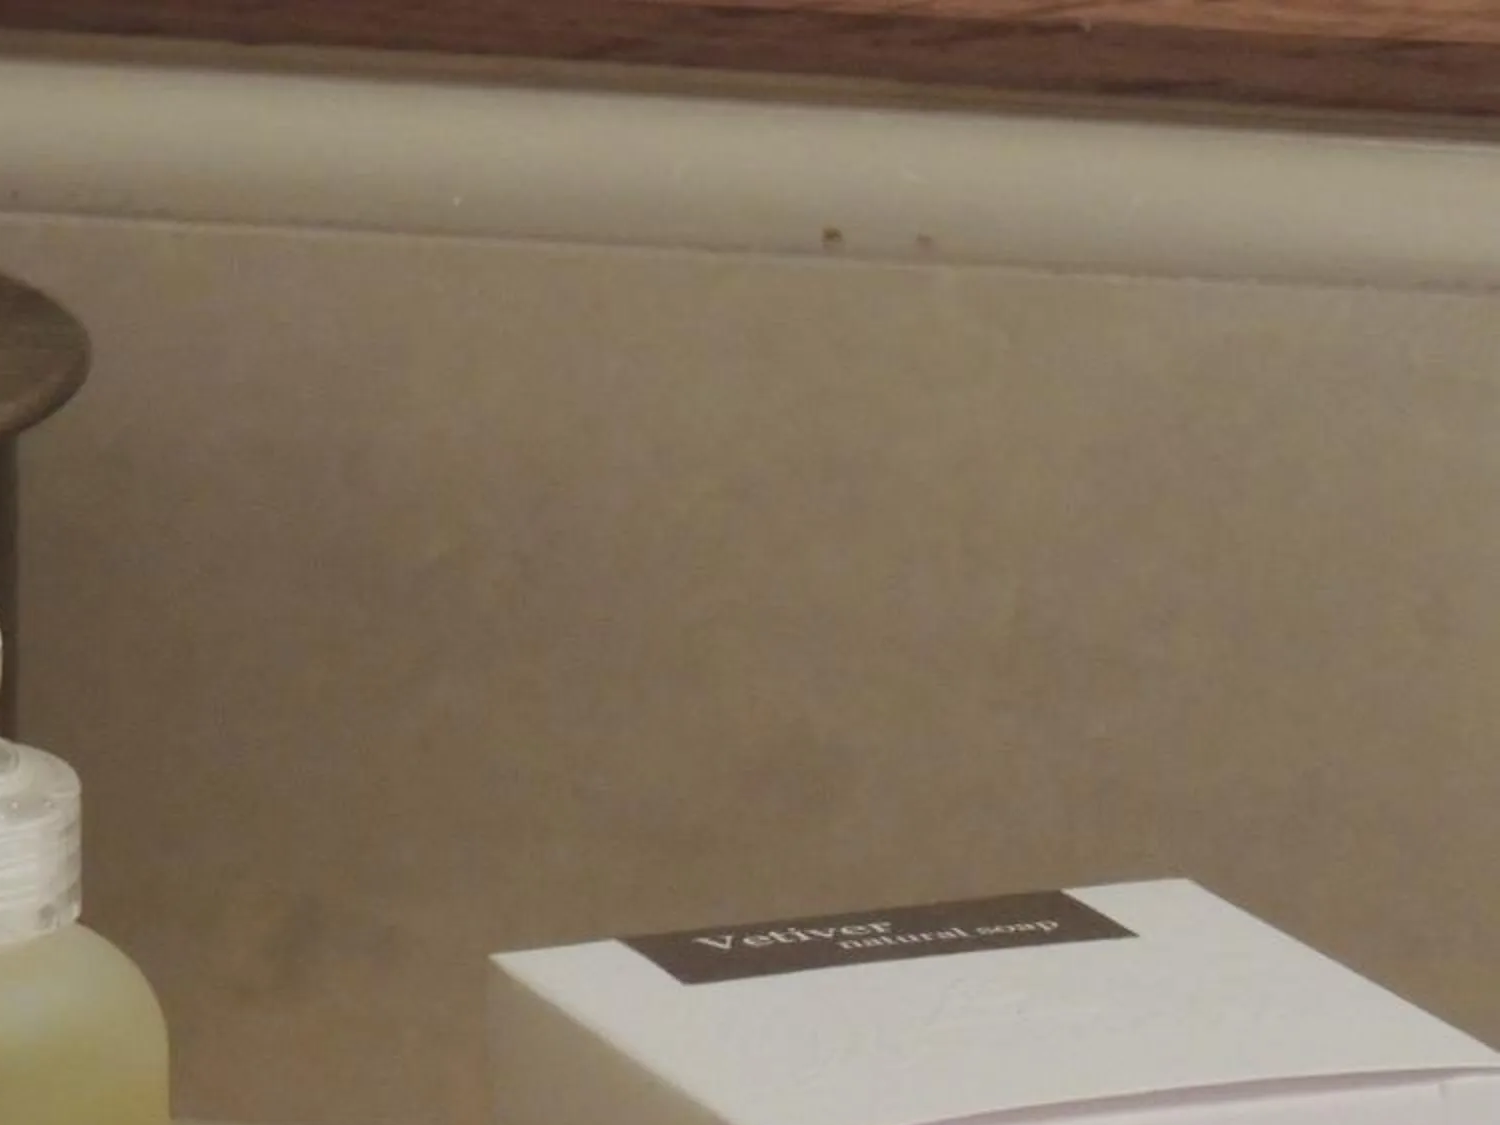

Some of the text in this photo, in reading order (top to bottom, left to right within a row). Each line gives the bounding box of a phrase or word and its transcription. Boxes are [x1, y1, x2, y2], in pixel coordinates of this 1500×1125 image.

[693, 919, 894, 955] Vetiver
[838, 917, 1059, 951] natural soap
